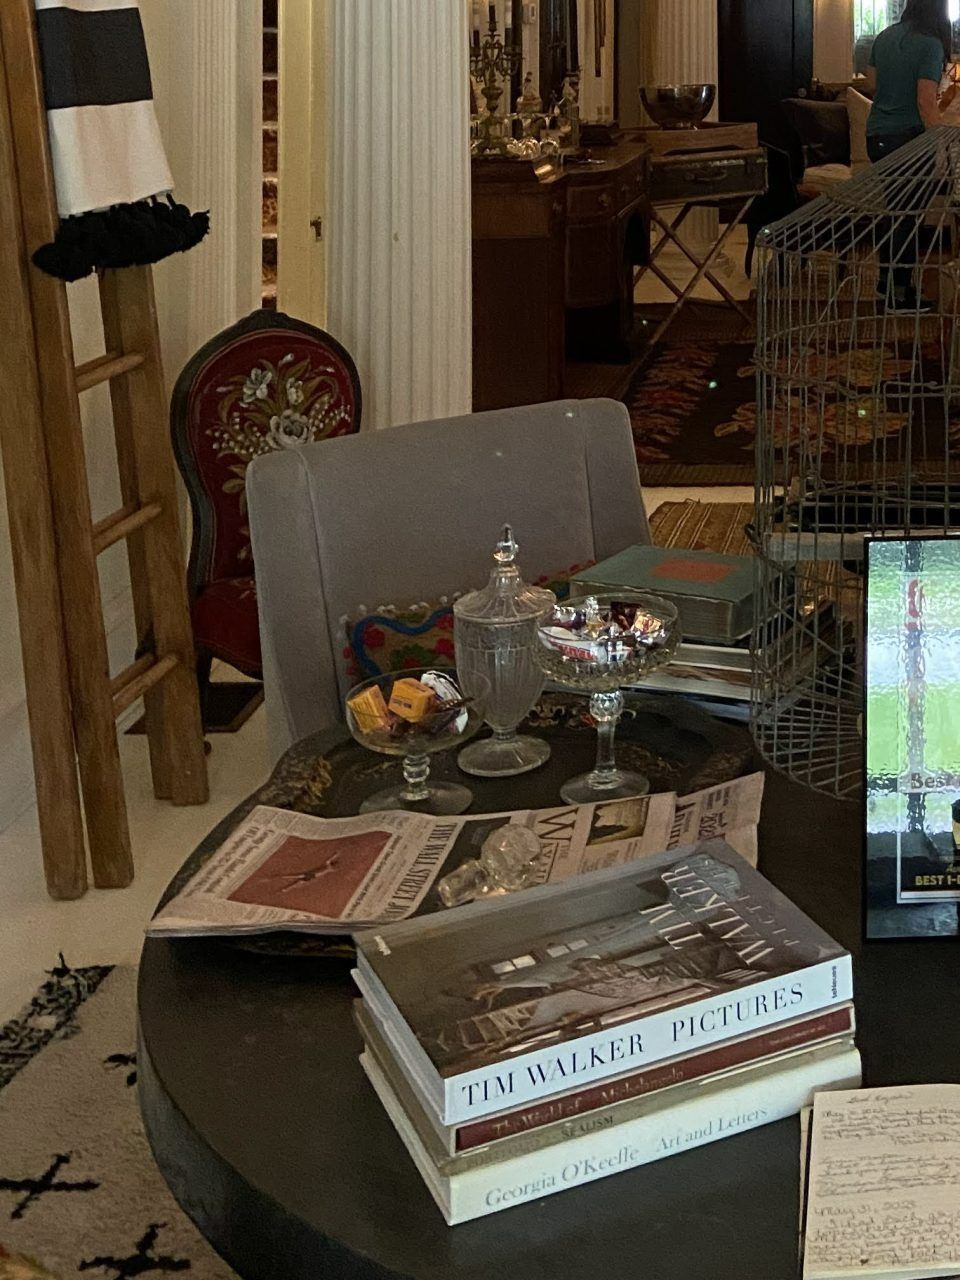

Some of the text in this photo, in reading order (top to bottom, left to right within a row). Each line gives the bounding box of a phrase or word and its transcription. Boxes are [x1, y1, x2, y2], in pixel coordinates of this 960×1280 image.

[392, 868, 430, 903] STREET
[415, 843, 447, 866] WALL
[914, 874, 945, 886] BEST
[661, 865, 776, 965] WALKER
[461, 1076, 515, 1106] TIM
[525, 1033, 645, 1087] WALKER
[671, 982, 805, 1043] PICTURES
[485, 1171, 557, 1209] Georgia
[560, 1145, 640, 1184] O'Keeffe
[655, 1131, 683, 1153] Art
[684, 1124, 715, 1145] and
[716, 1107, 769, 1136] Letters
